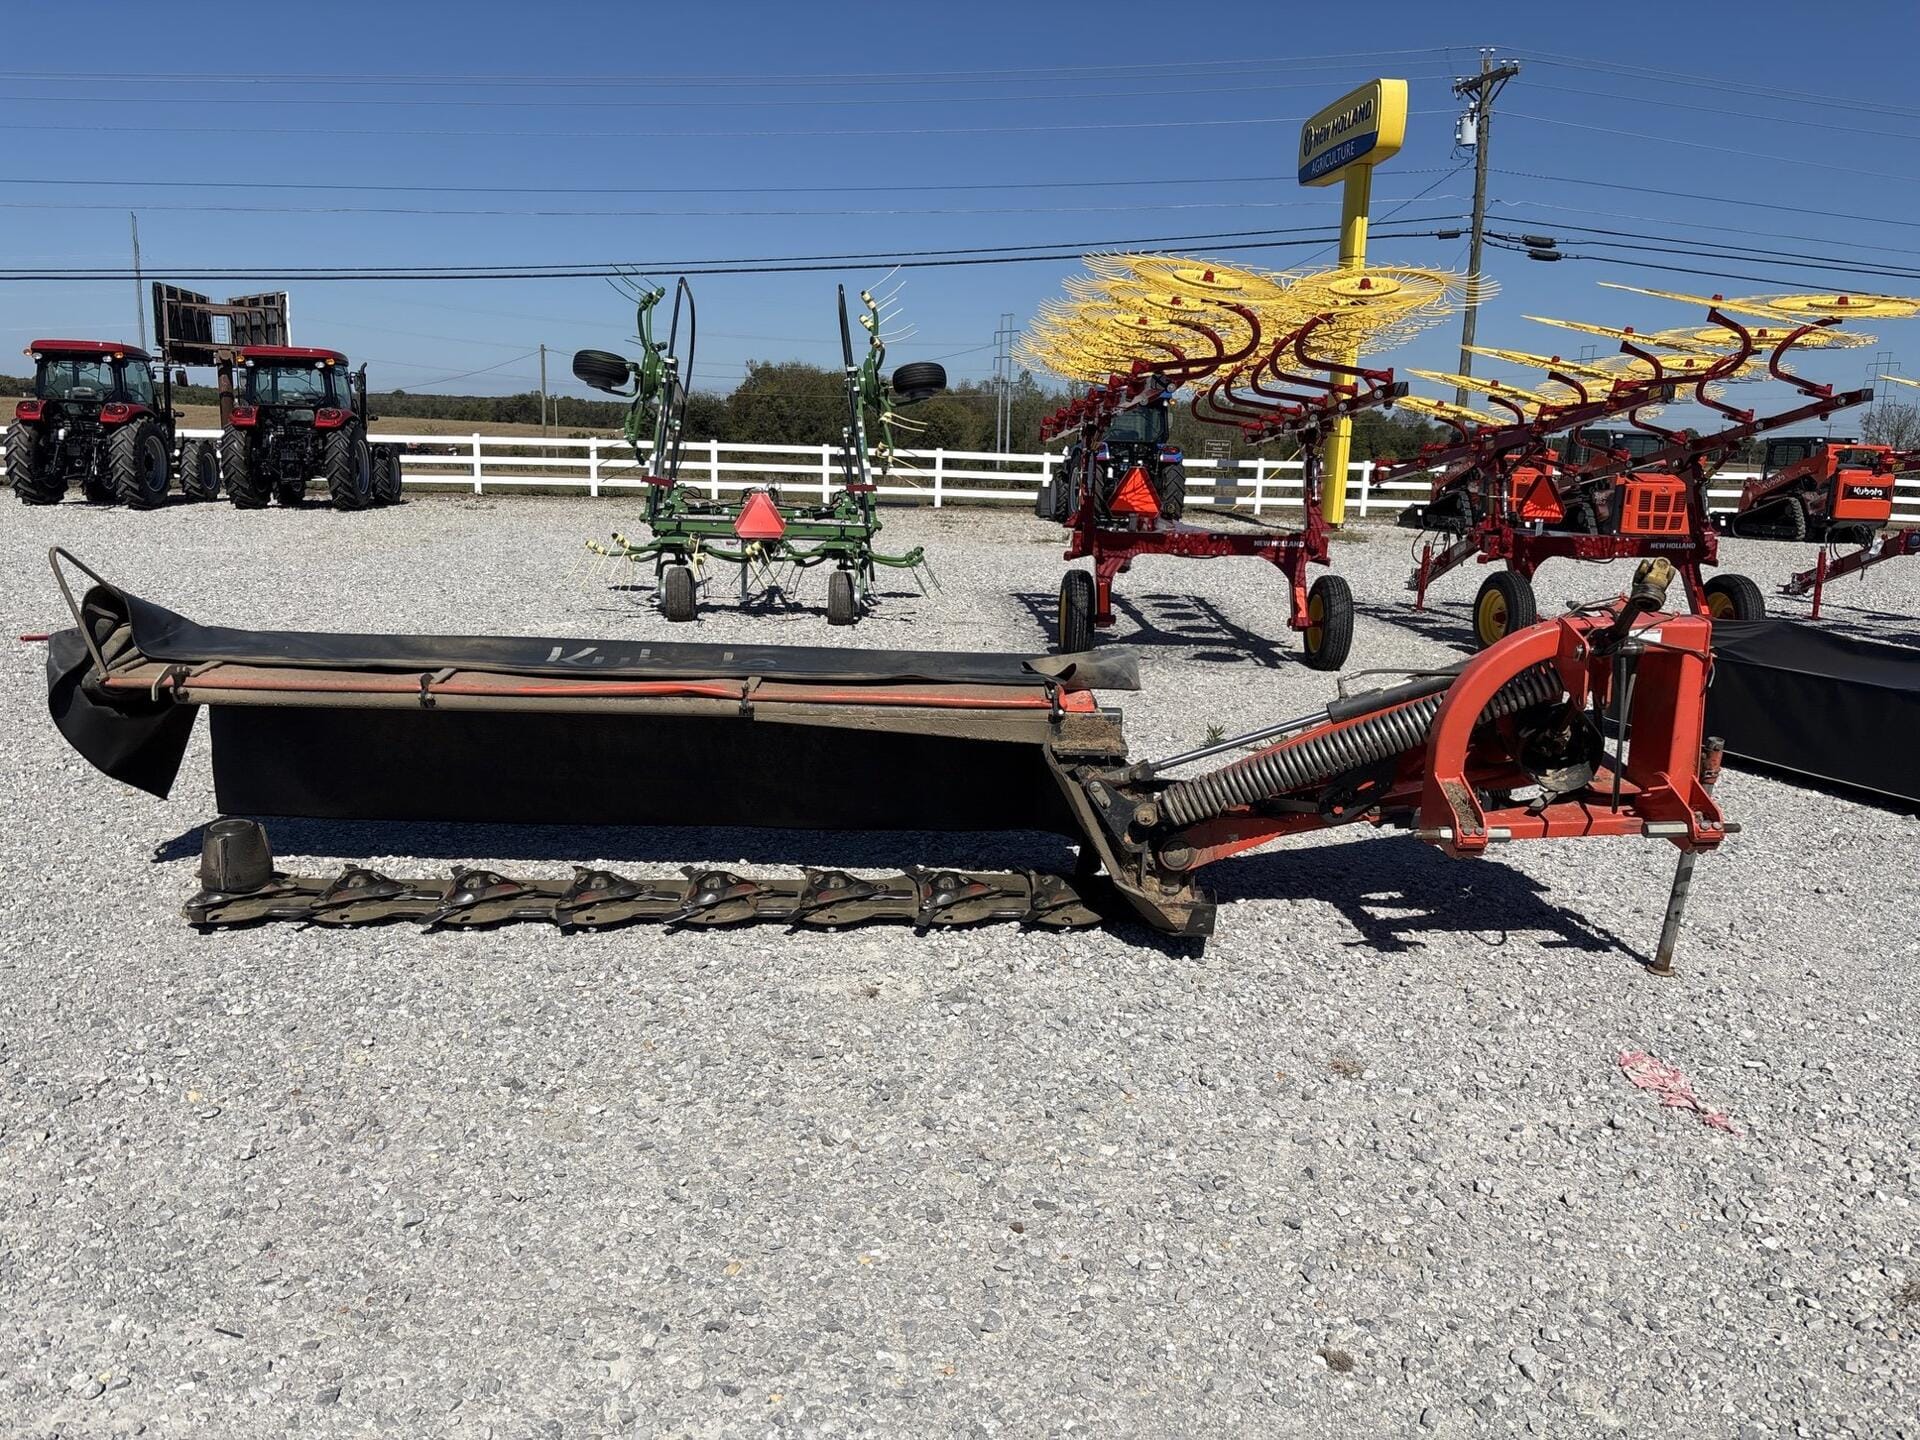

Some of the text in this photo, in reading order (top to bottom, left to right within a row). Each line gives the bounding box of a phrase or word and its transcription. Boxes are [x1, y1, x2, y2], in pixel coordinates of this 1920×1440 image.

[1313, 98, 1374, 148] NEW HOLLAND
[1311, 141, 1355, 175] AGRICULTURE
[1853, 486, 1883, 496] Kubota
[1271, 540, 1305, 548] HOLLAND
